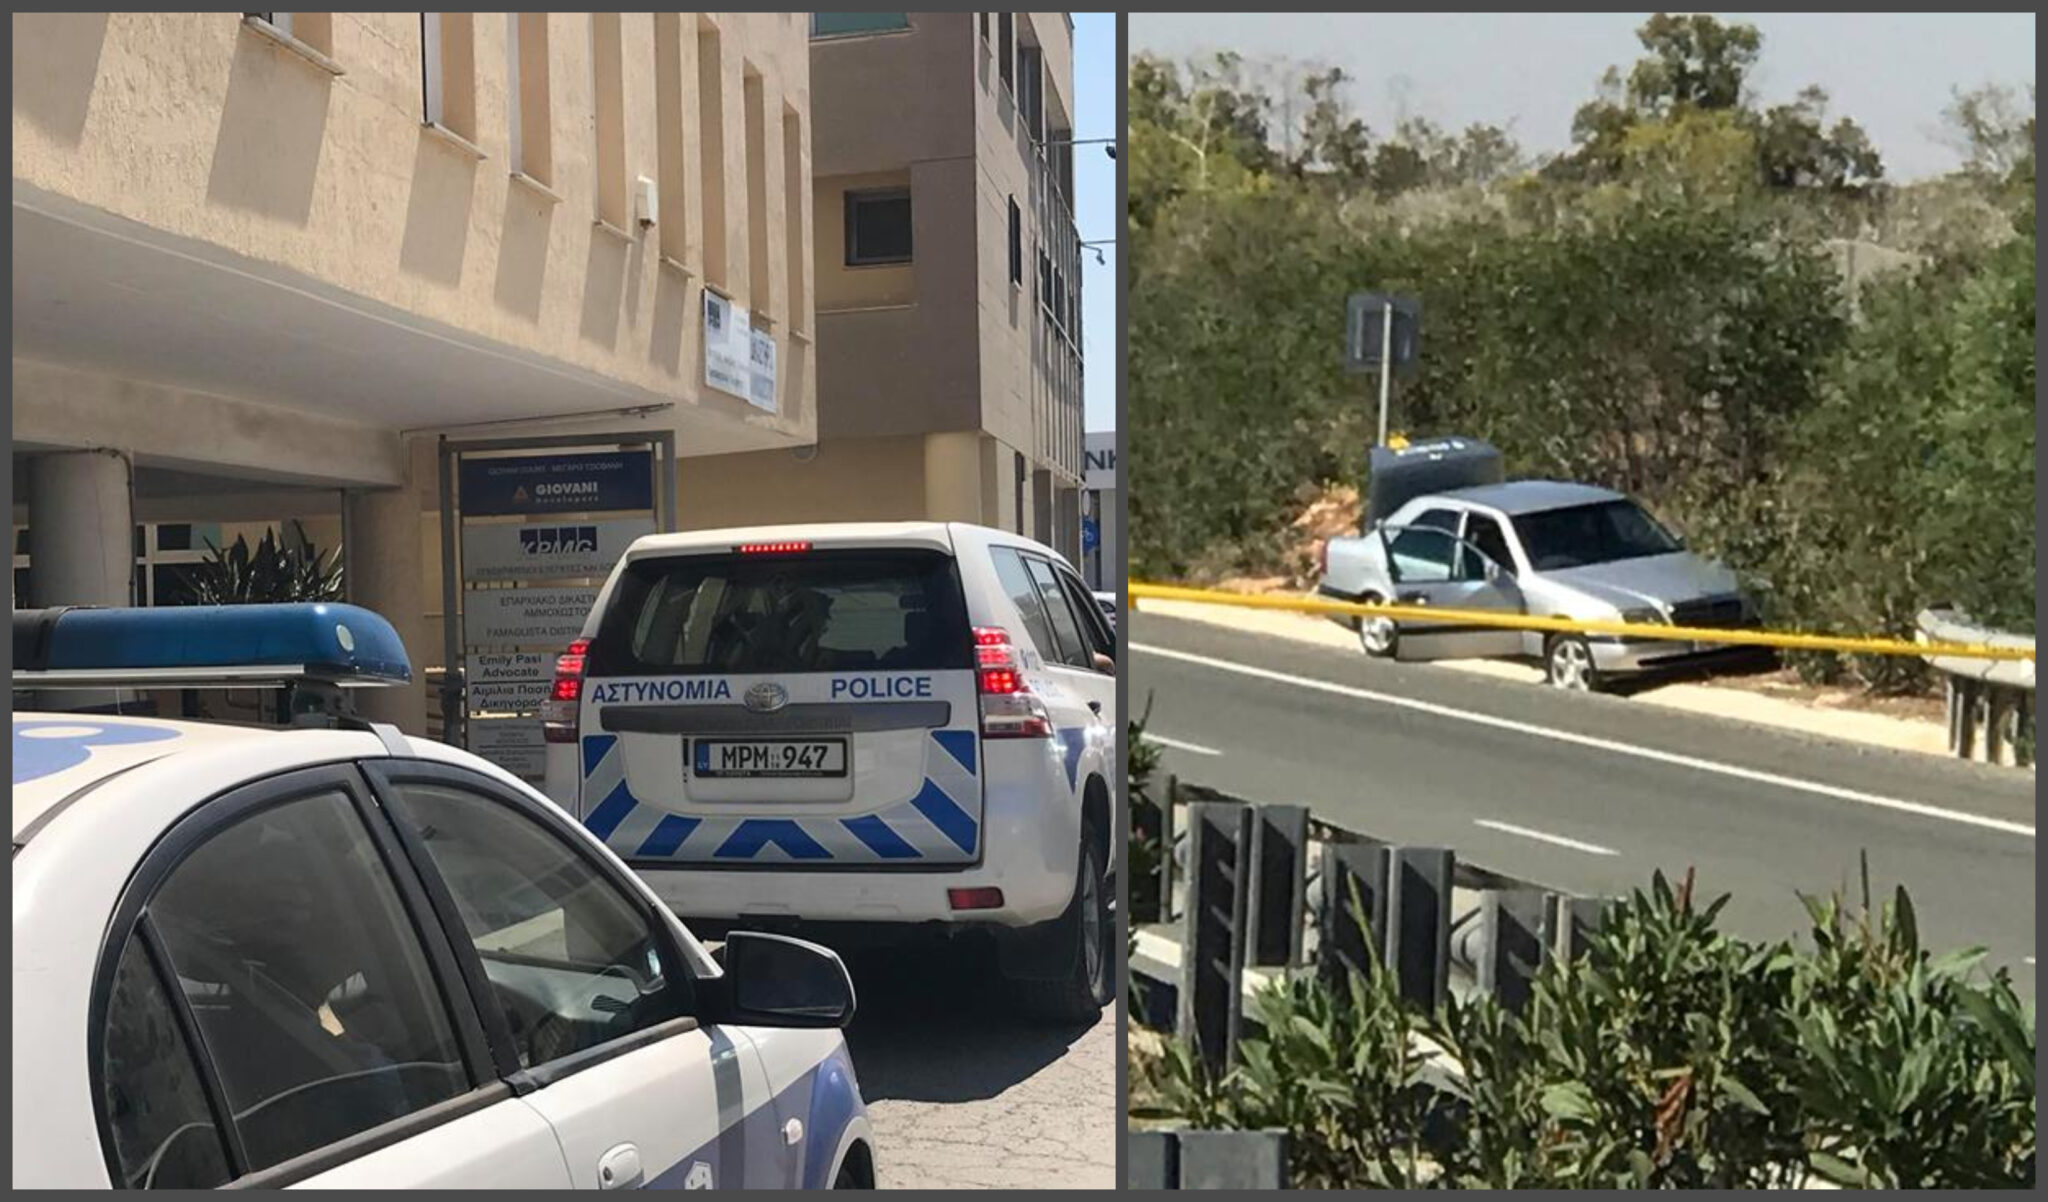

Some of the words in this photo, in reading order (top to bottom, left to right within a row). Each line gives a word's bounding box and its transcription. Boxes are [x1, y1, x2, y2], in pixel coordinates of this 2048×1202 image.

[535, 481, 598, 496] GIOVANI
[524, 606, 592, 617] ΑΜΜΟΧΩΣΤΟ
[479, 656, 512, 667] Emily
[516, 655, 542, 664] Pasi
[482, 667, 539, 678] Advocate
[591, 679, 731, 704] ΑΣΤΥΝΟΜΙΑ
[831, 677, 932, 699] POLICE
[721, 745, 769, 769] MPM
[782, 745, 828, 769] 947
